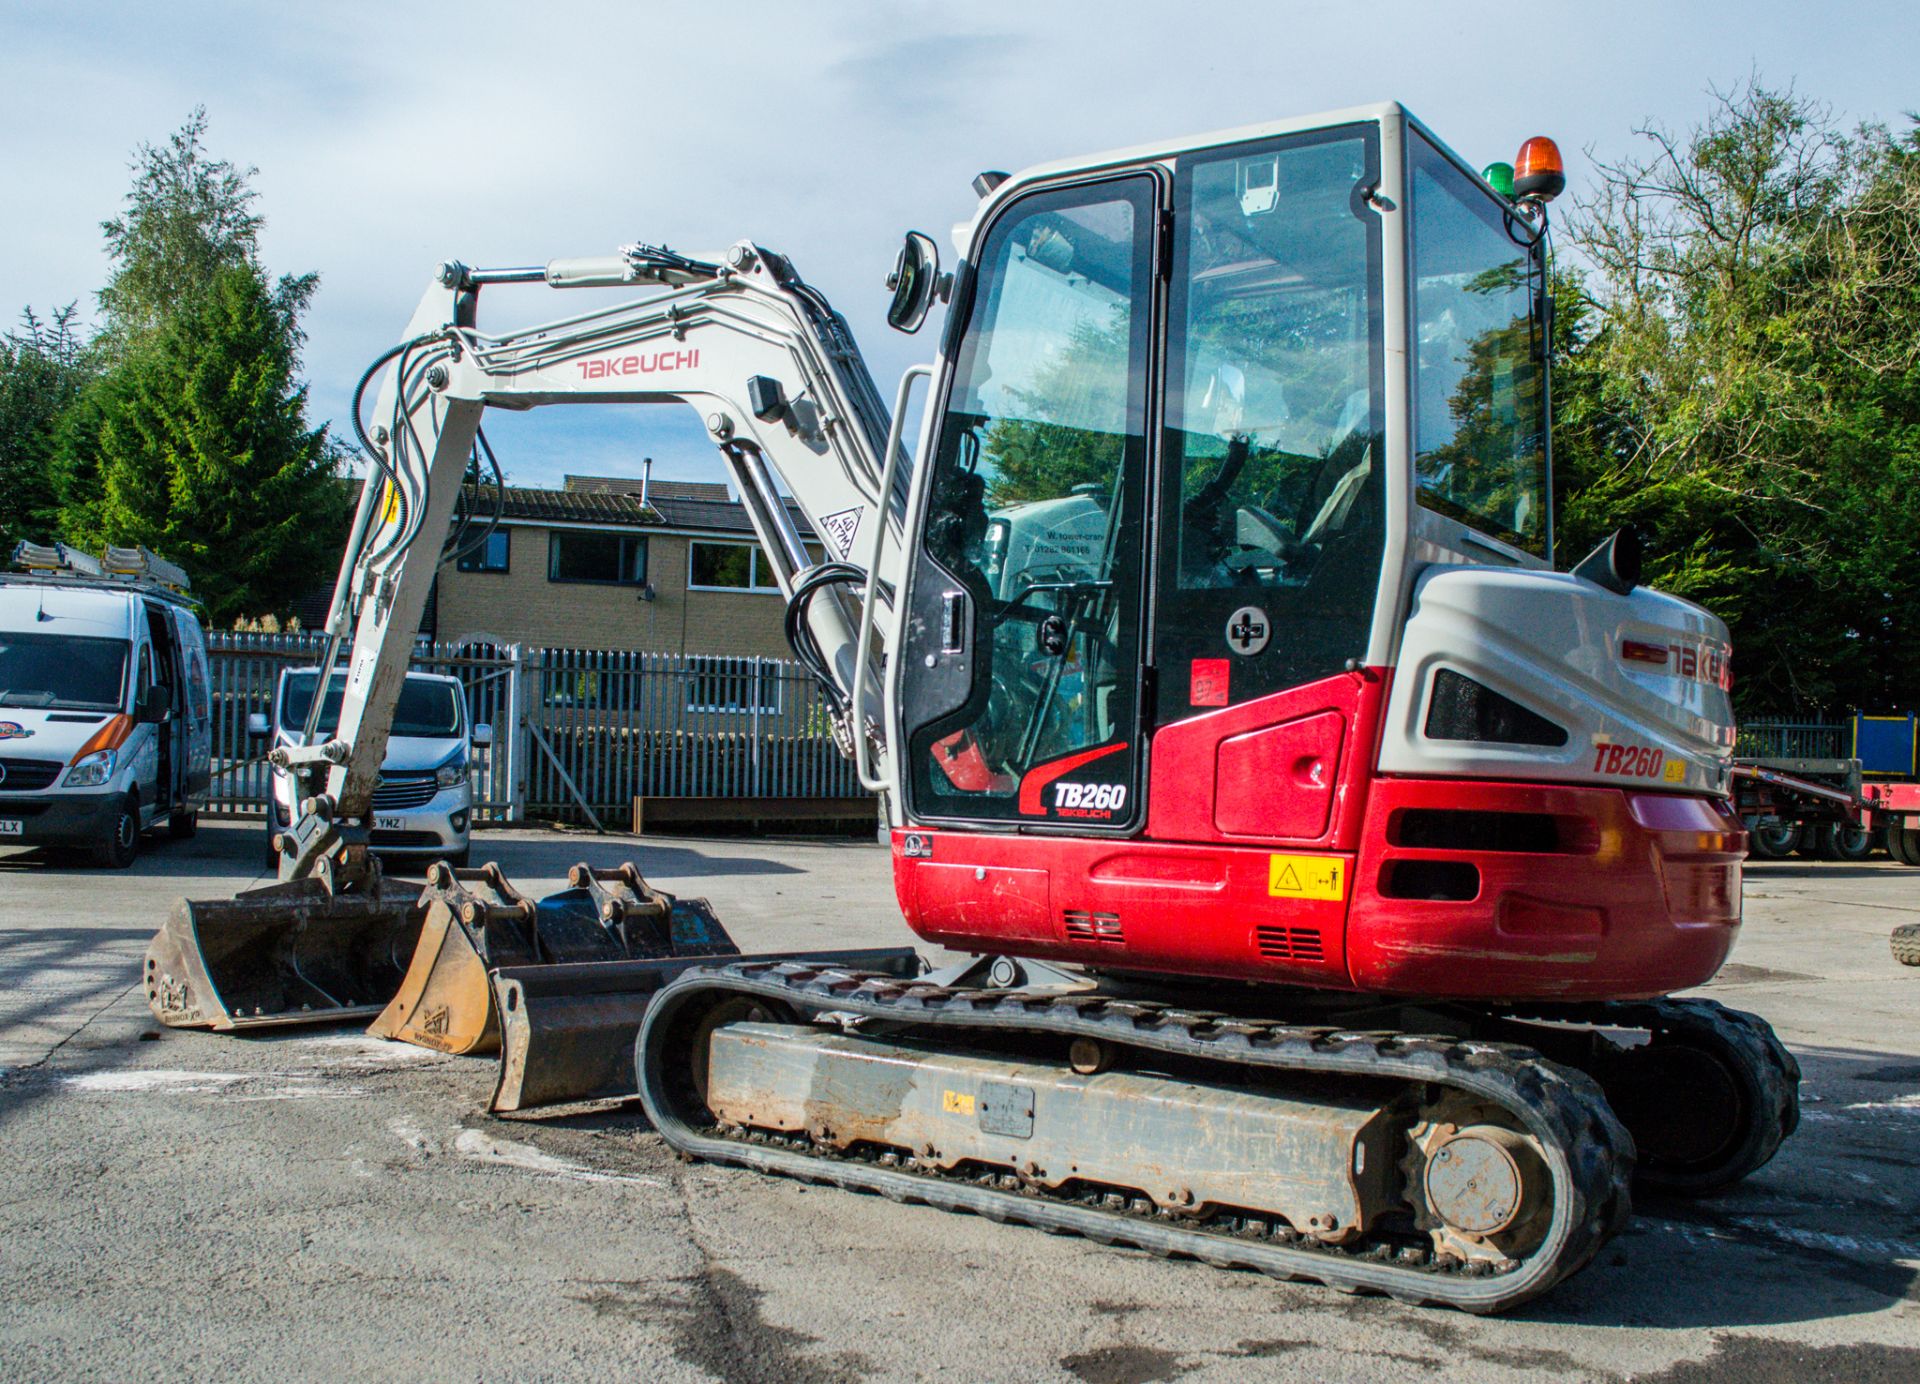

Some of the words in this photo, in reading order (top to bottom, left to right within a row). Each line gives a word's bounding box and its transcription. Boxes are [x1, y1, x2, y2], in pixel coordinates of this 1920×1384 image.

[829, 518, 850, 548] AT7M
[1593, 743, 1663, 778] TB260
[1055, 783, 1127, 809] TB260
[379, 818, 400, 829] YMZ
